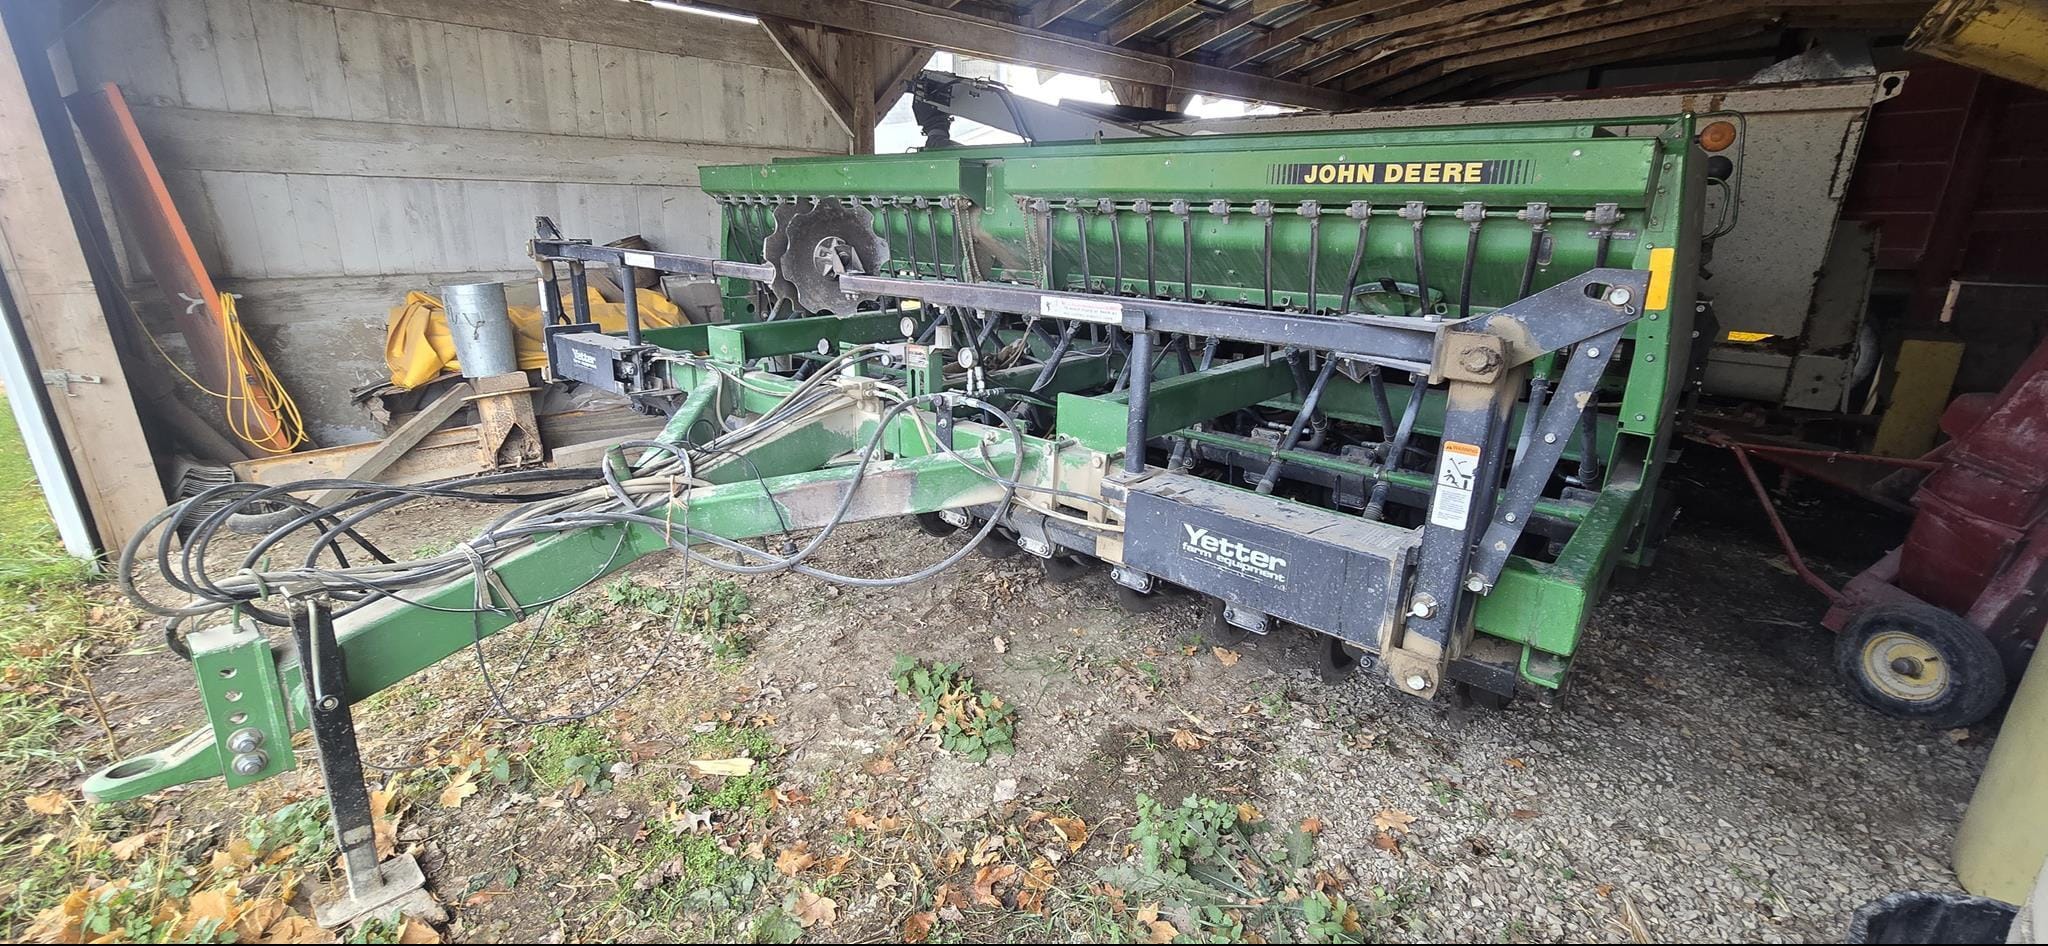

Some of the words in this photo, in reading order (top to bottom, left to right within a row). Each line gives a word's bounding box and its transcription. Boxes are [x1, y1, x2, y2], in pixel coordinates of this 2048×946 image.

[1304, 164, 1374, 184] JOHN
[1384, 162, 1483, 183] DEERE
[1182, 541, 1212, 558] farm
[1216, 555, 1286, 583] equipment
[1183, 523, 1287, 571] Yetter
